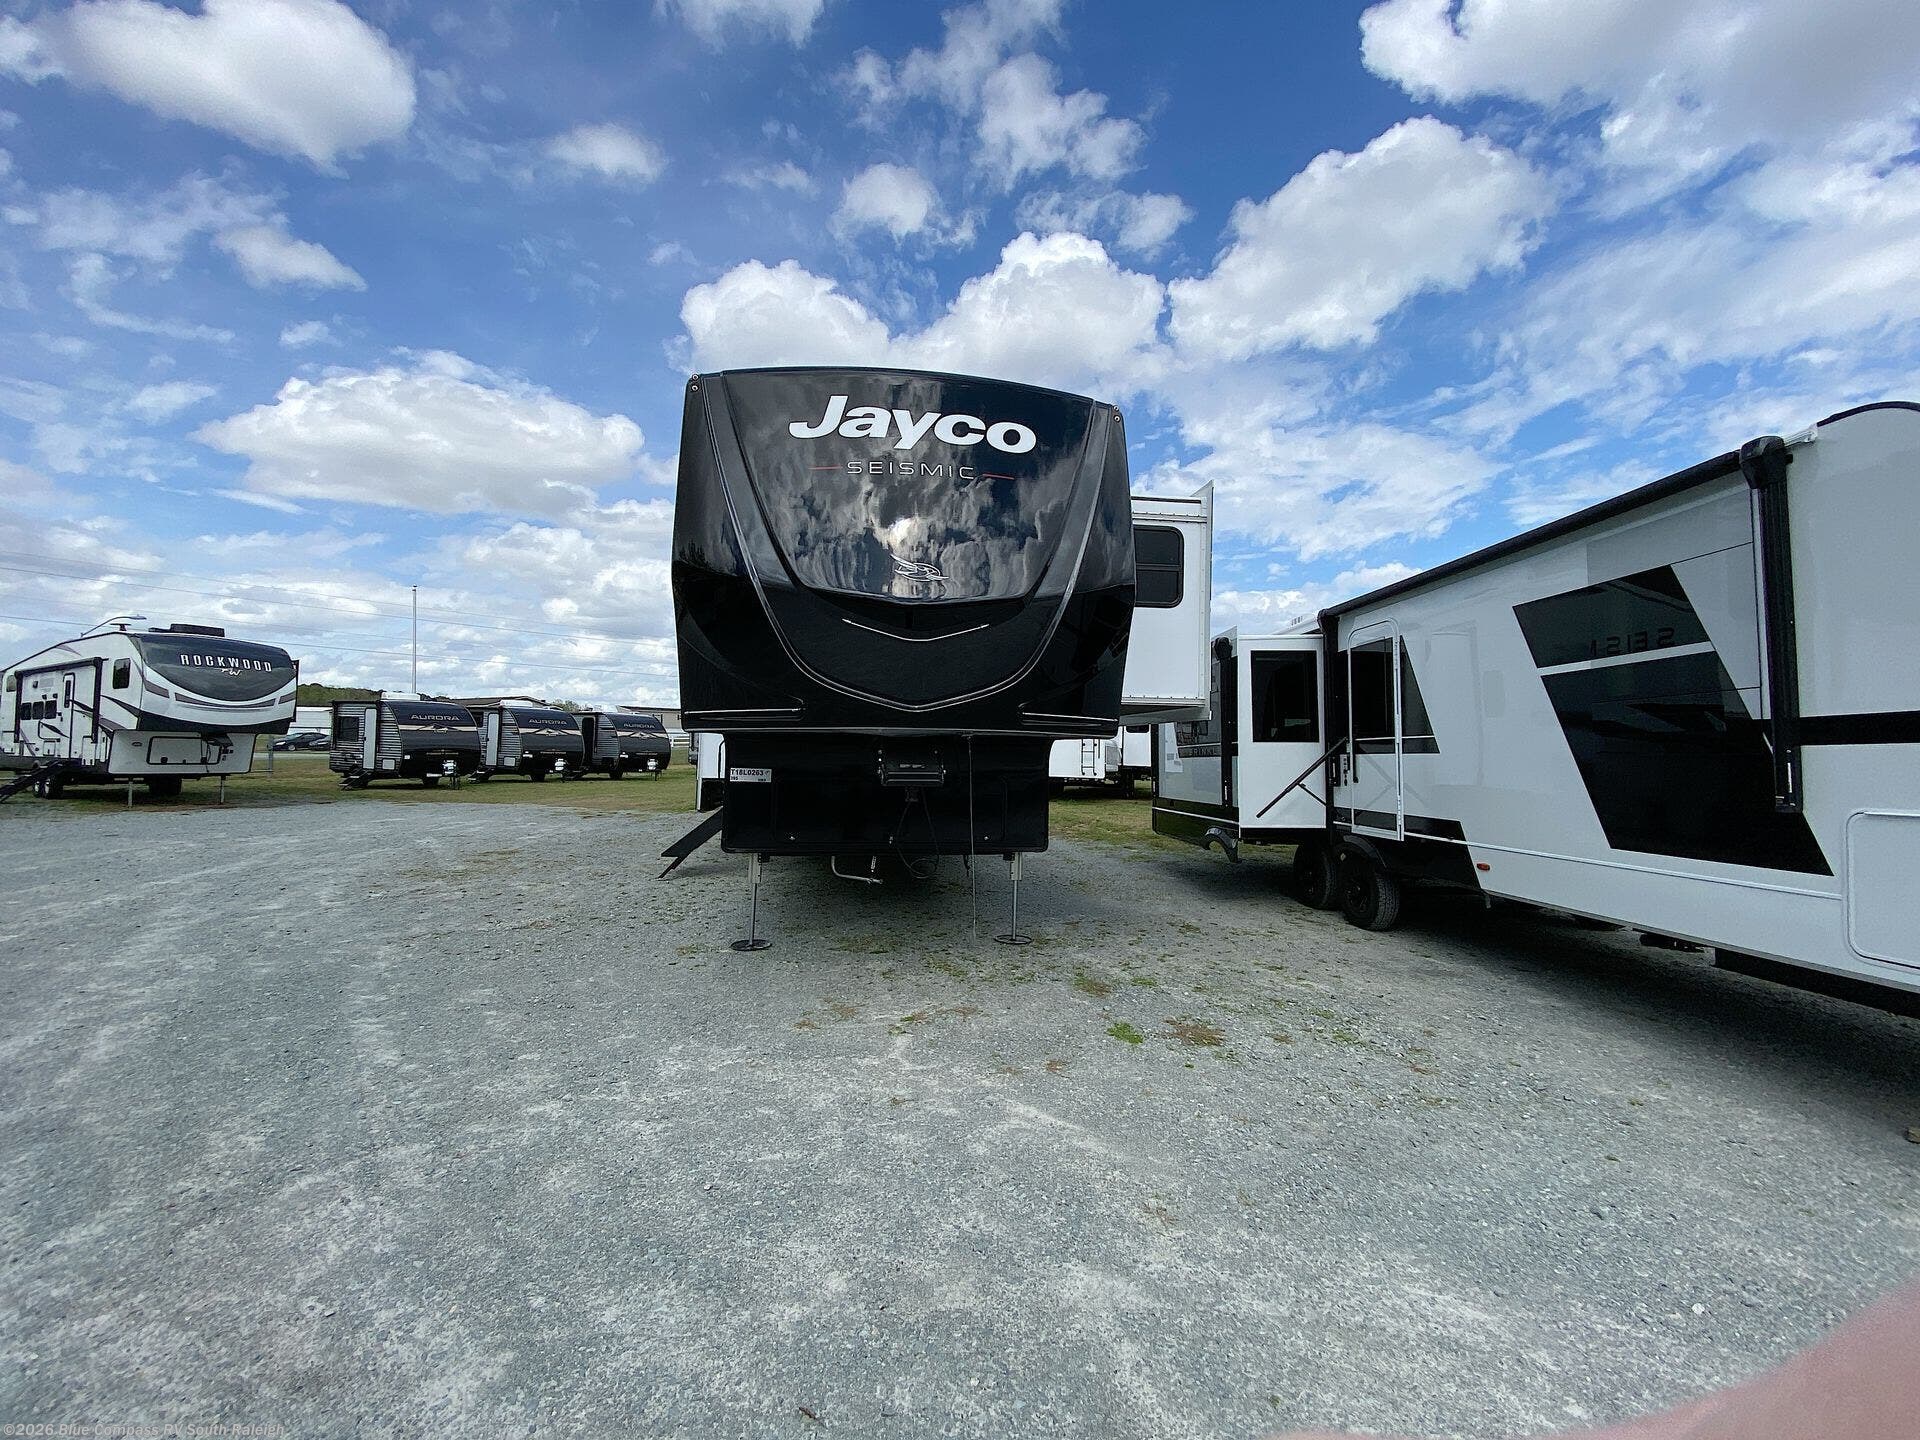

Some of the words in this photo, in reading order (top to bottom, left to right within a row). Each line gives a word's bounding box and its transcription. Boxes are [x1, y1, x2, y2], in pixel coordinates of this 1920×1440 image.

[788, 395, 1037, 454] Jayco
[846, 461, 976, 480] SEISMIC
[180, 654, 272, 672] ROCKWOOD
